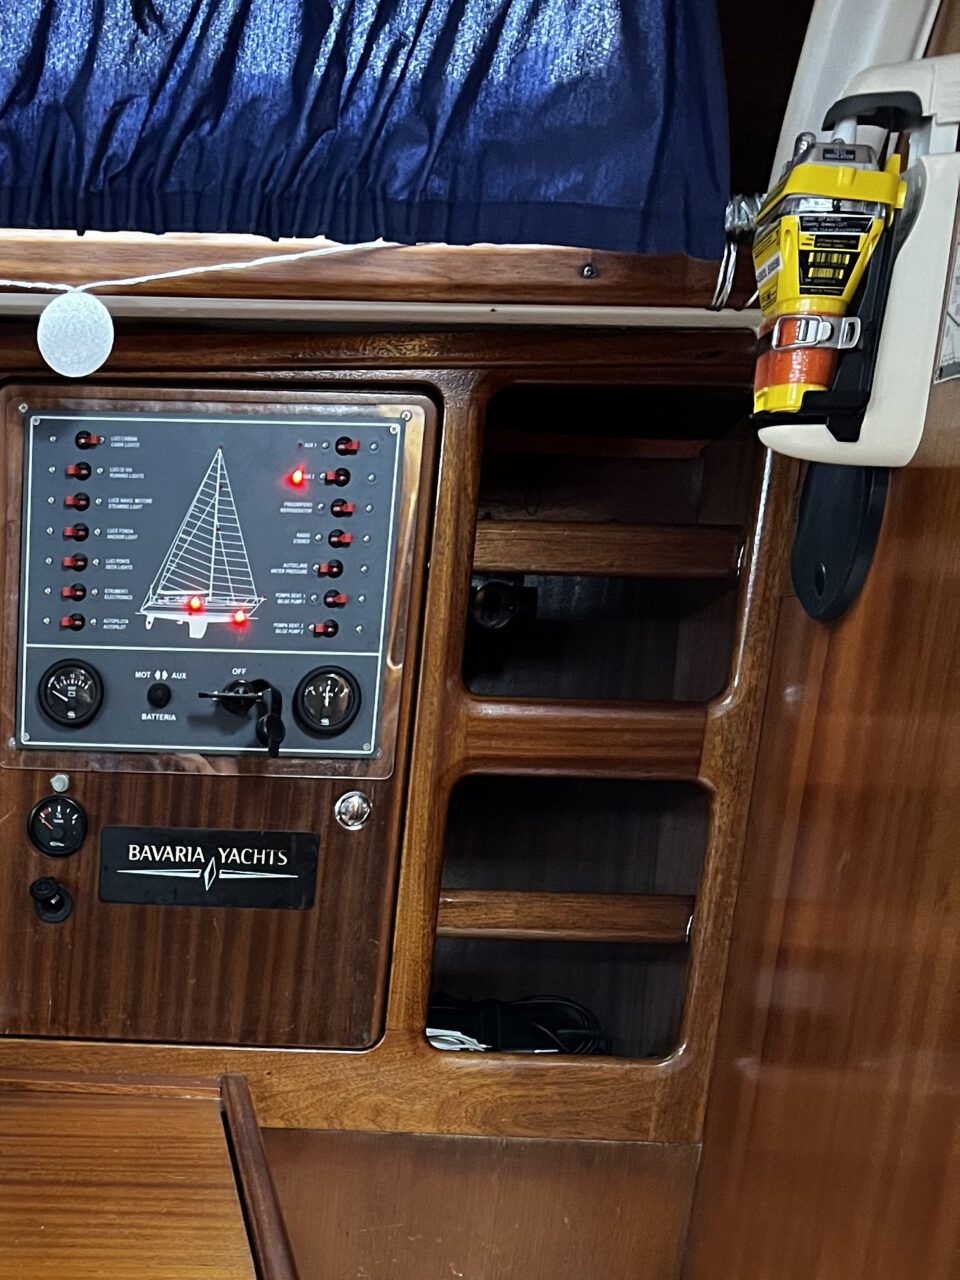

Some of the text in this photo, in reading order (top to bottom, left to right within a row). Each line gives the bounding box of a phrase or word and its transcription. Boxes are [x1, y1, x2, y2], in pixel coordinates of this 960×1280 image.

[141, 713, 176, 721] BATTERIA
[128, 844, 288, 866] BAVARIA YACHTS
